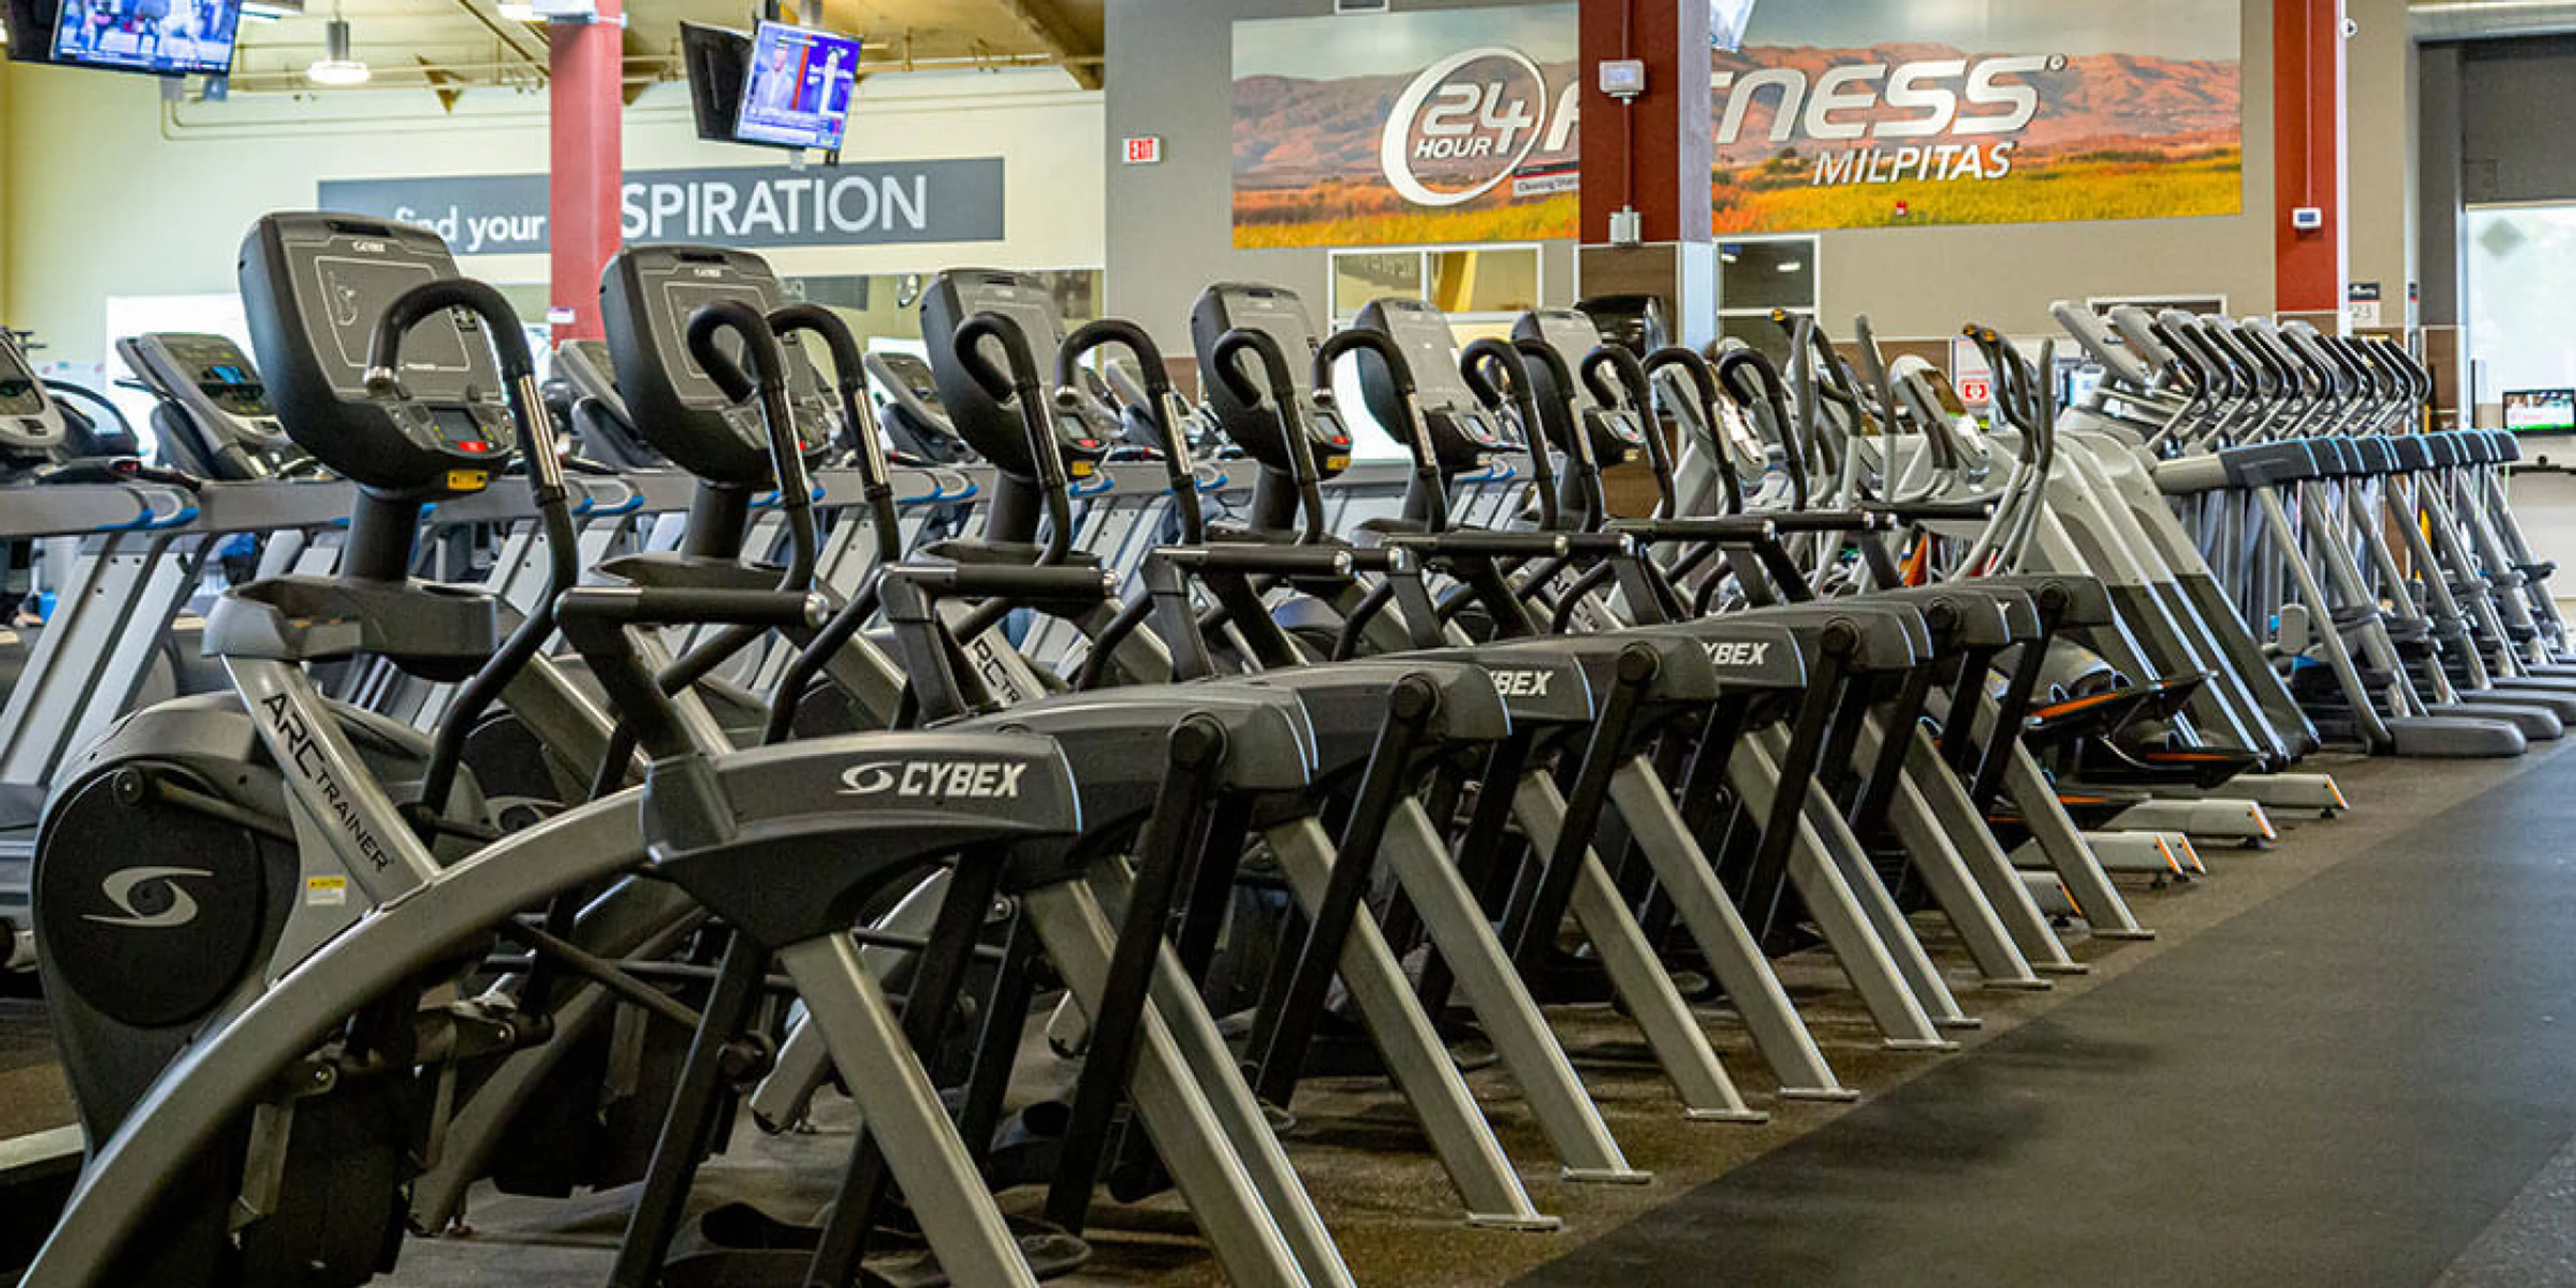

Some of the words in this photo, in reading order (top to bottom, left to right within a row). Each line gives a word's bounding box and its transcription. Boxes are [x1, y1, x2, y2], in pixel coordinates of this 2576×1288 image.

[1421, 82, 1534, 154] 24
[1129, 139, 1153, 160] EXIT
[1414, 136, 1493, 158] HOUR
[1813, 140, 2015, 185] MILPITAS
[466, 216, 547, 252] your
[898, 761, 1027, 797] CYBEX
